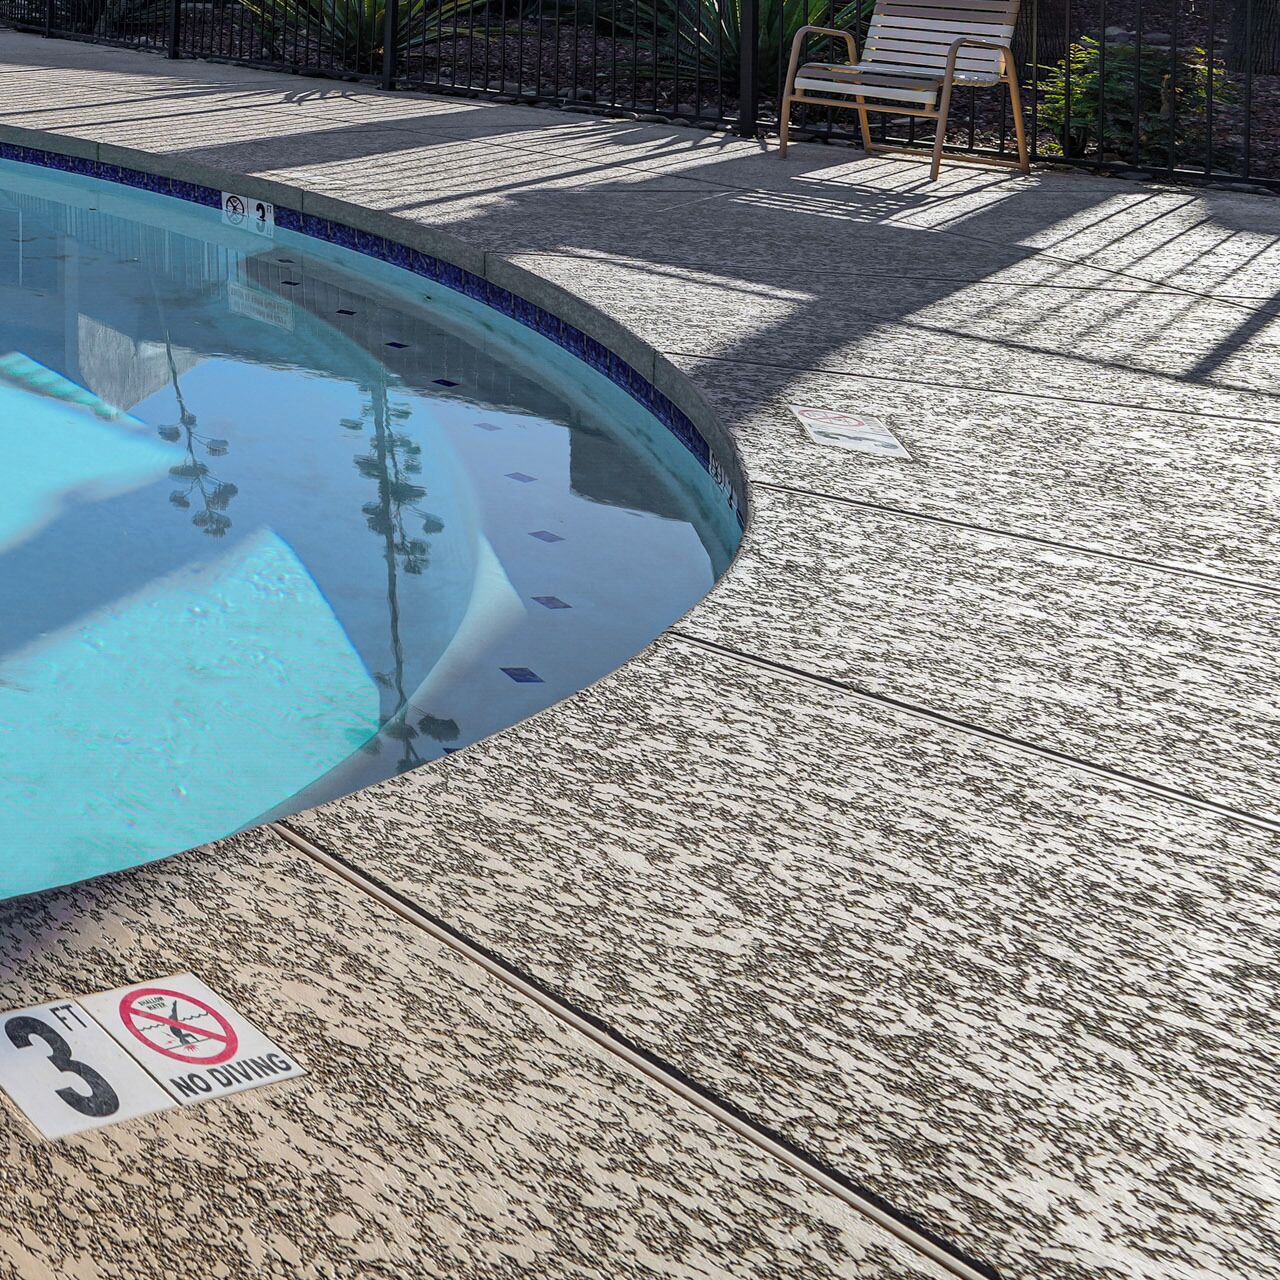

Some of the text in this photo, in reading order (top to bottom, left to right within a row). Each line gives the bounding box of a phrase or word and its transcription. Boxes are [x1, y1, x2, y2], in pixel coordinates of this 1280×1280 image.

[4, 1003, 120, 1117] 3 FT
[169, 1053, 293, 1098] NO DIVING
